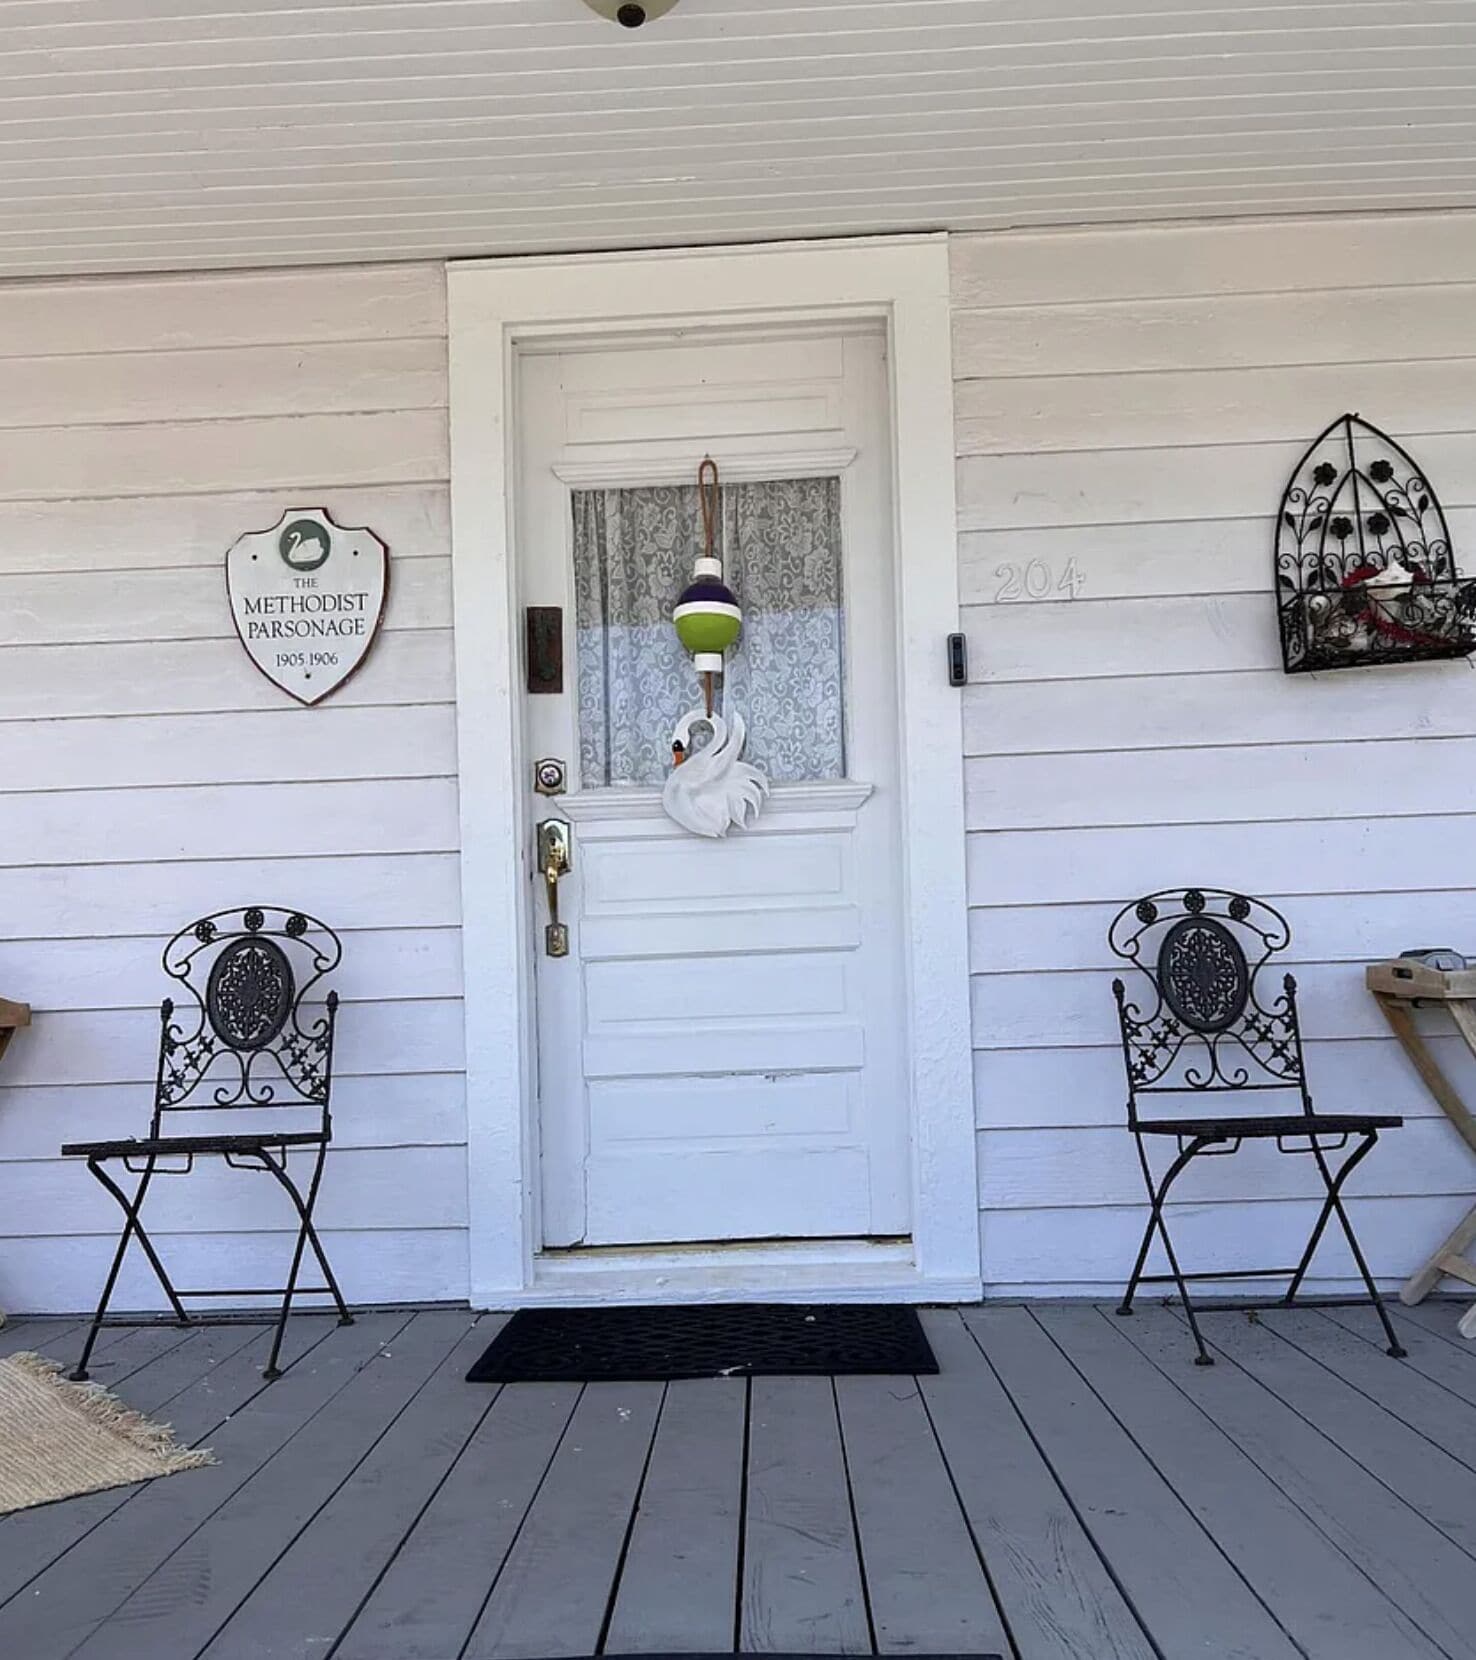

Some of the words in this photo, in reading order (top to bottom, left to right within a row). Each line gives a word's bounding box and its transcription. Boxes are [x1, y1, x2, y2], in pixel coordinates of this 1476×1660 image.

[293, 578, 318, 588] THE
[995, 556, 1085, 602] 204
[244, 594, 368, 614] METHODIST
[248, 619, 365, 639] PARSONAGE
